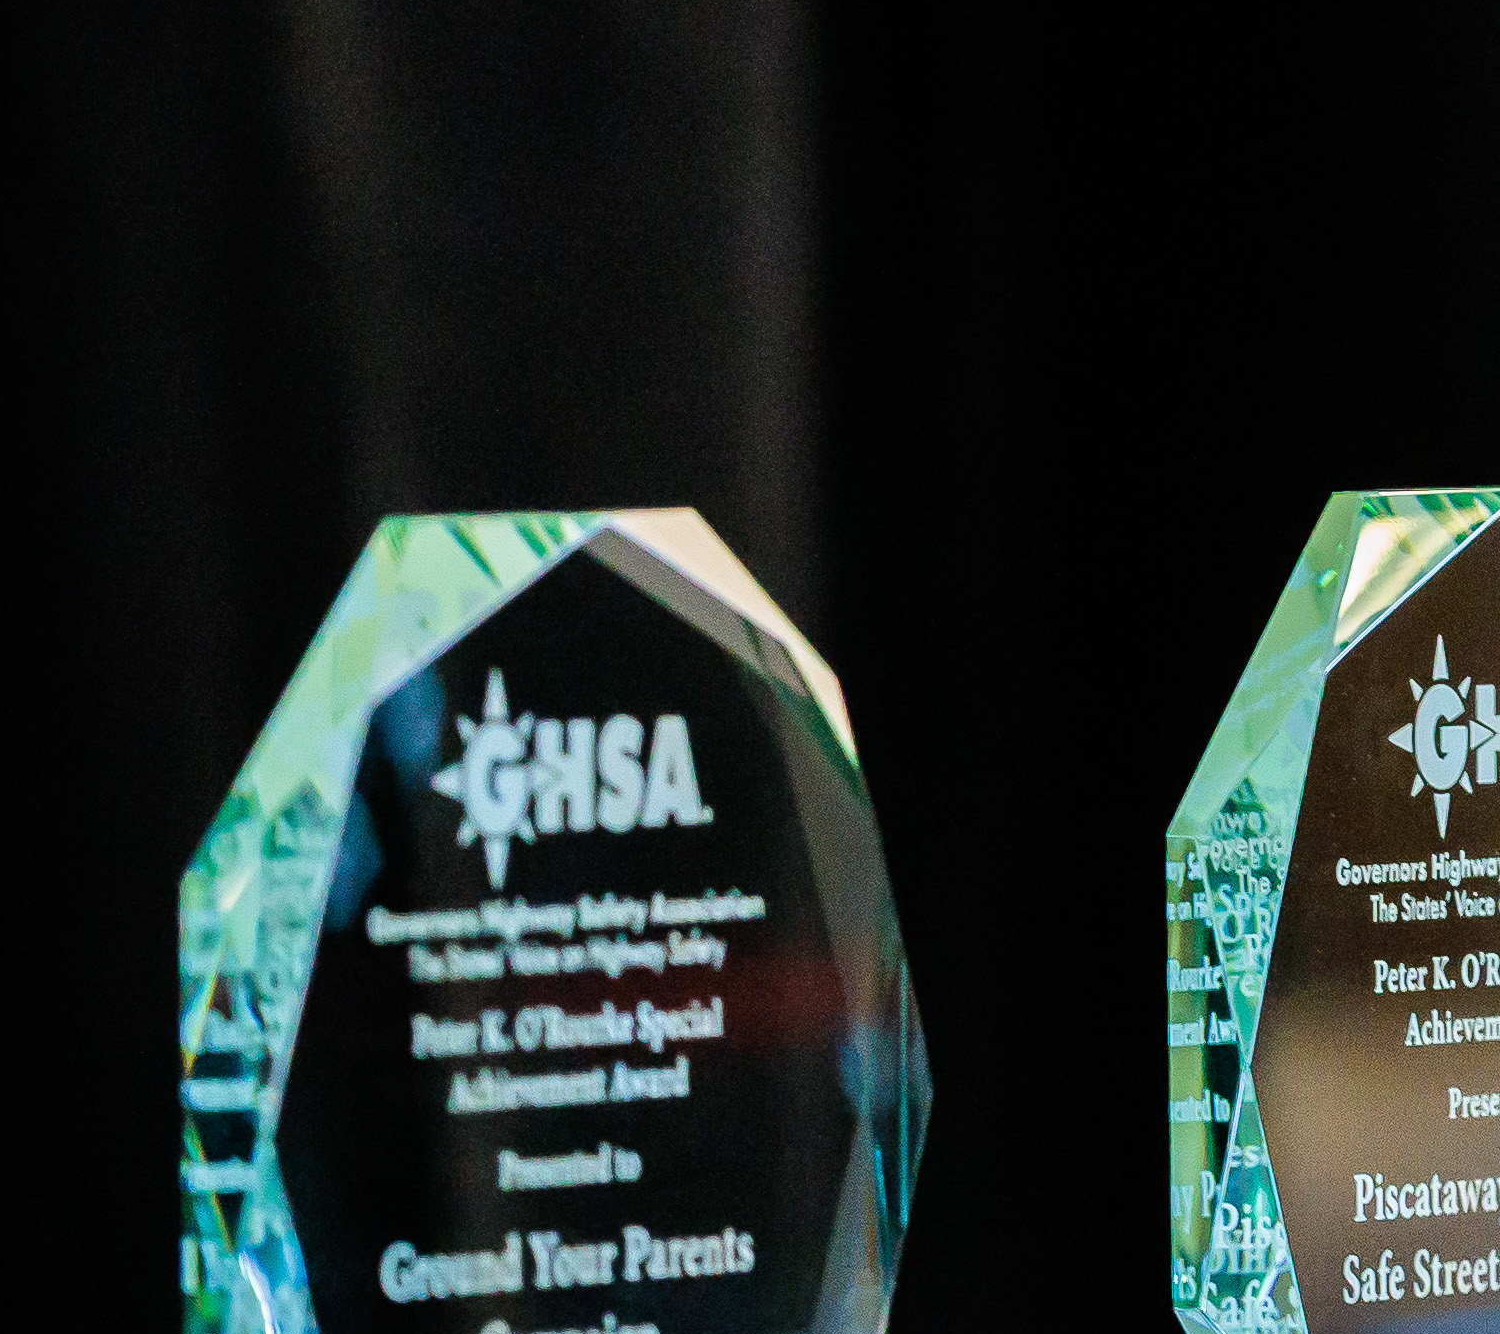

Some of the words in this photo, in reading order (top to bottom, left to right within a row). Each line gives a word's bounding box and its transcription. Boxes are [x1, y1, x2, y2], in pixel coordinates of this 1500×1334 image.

[465, 714, 714, 834] GHSA
[1335, 857, 1428, 886] Governors
[1370, 893, 1398, 923] The
[1454, 889, 1495, 917] Voice
[1374, 959, 1427, 994] Peter
[1432, 955, 1456, 990] K.
[636, 996, 724, 1053] Special
[447, 1067, 607, 1114] Achievement
[609, 1055, 690, 1102] Award
[498, 1141, 613, 1191] Presented
[614, 1146, 643, 1183] to
[379, 1231, 523, 1303] Ground
[527, 1231, 618, 1291] Your
[622, 1224, 755, 1282] Parents
[1342, 1248, 1405, 1305] Safe
